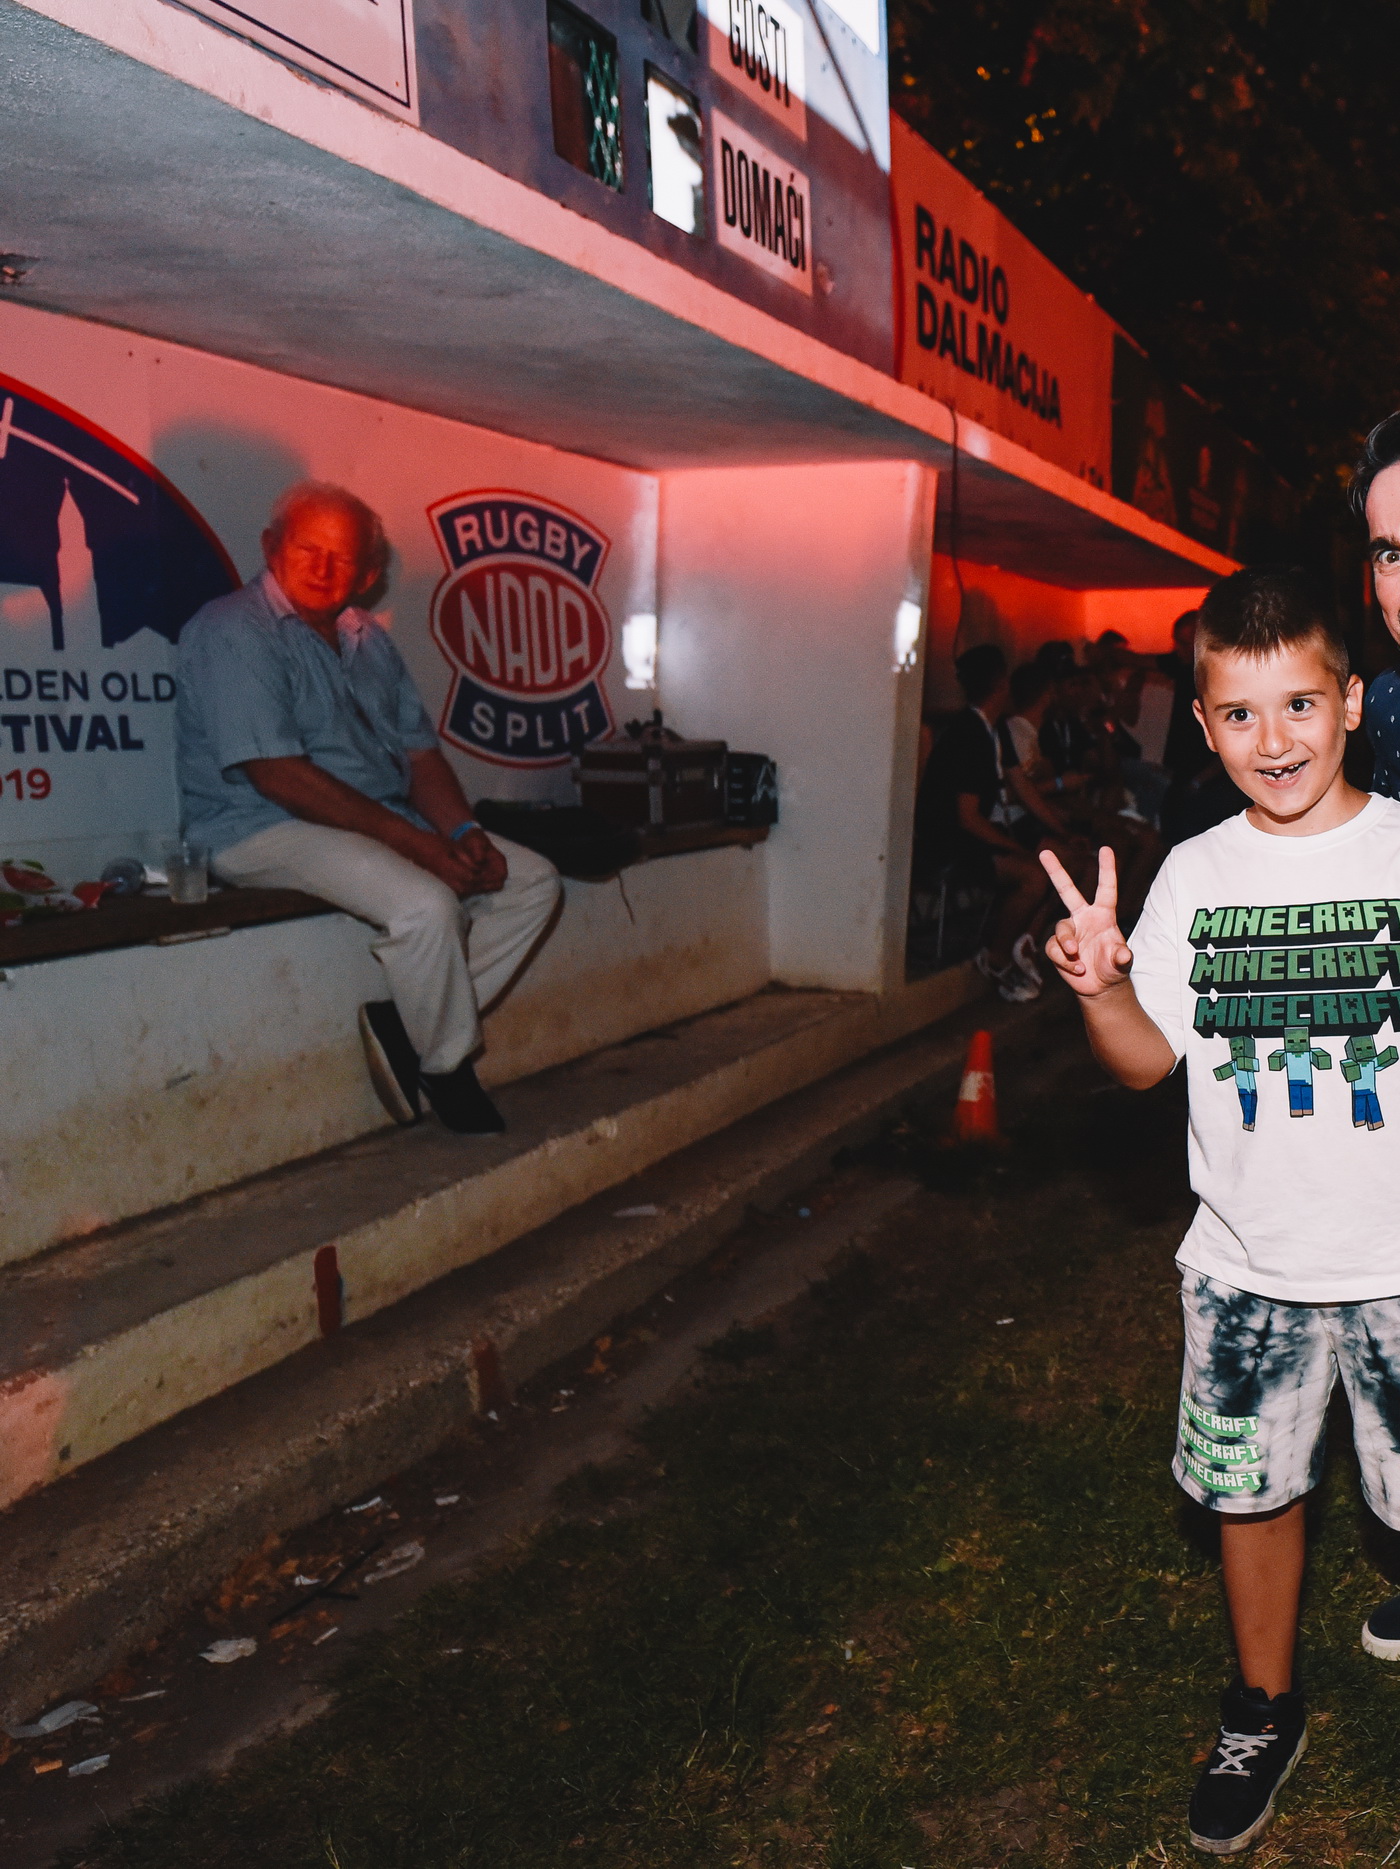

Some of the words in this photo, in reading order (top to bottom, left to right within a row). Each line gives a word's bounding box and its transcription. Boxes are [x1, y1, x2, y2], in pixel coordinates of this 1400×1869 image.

[728, 0, 790, 108] GOSTI
[721, 137, 806, 272] DOMAĆI
[916, 203, 1010, 327] RADIO
[916, 281, 1063, 430] DALMACIJA
[453, 509, 592, 571] RUGBY
[461, 571, 590, 687] NADA
[0, 668, 90, 702] DEN
[100, 671, 177, 702] OLD
[0, 714, 145, 754] TIVAL
[470, 700, 590, 748] SPLIT
[0, 767, 52, 801] 19
[1182, 1390, 1258, 1437] MINECRAFT
[1181, 1418, 1260, 1465] MINECRAFT
[1182, 1446, 1261, 1492] MINECRAFT
